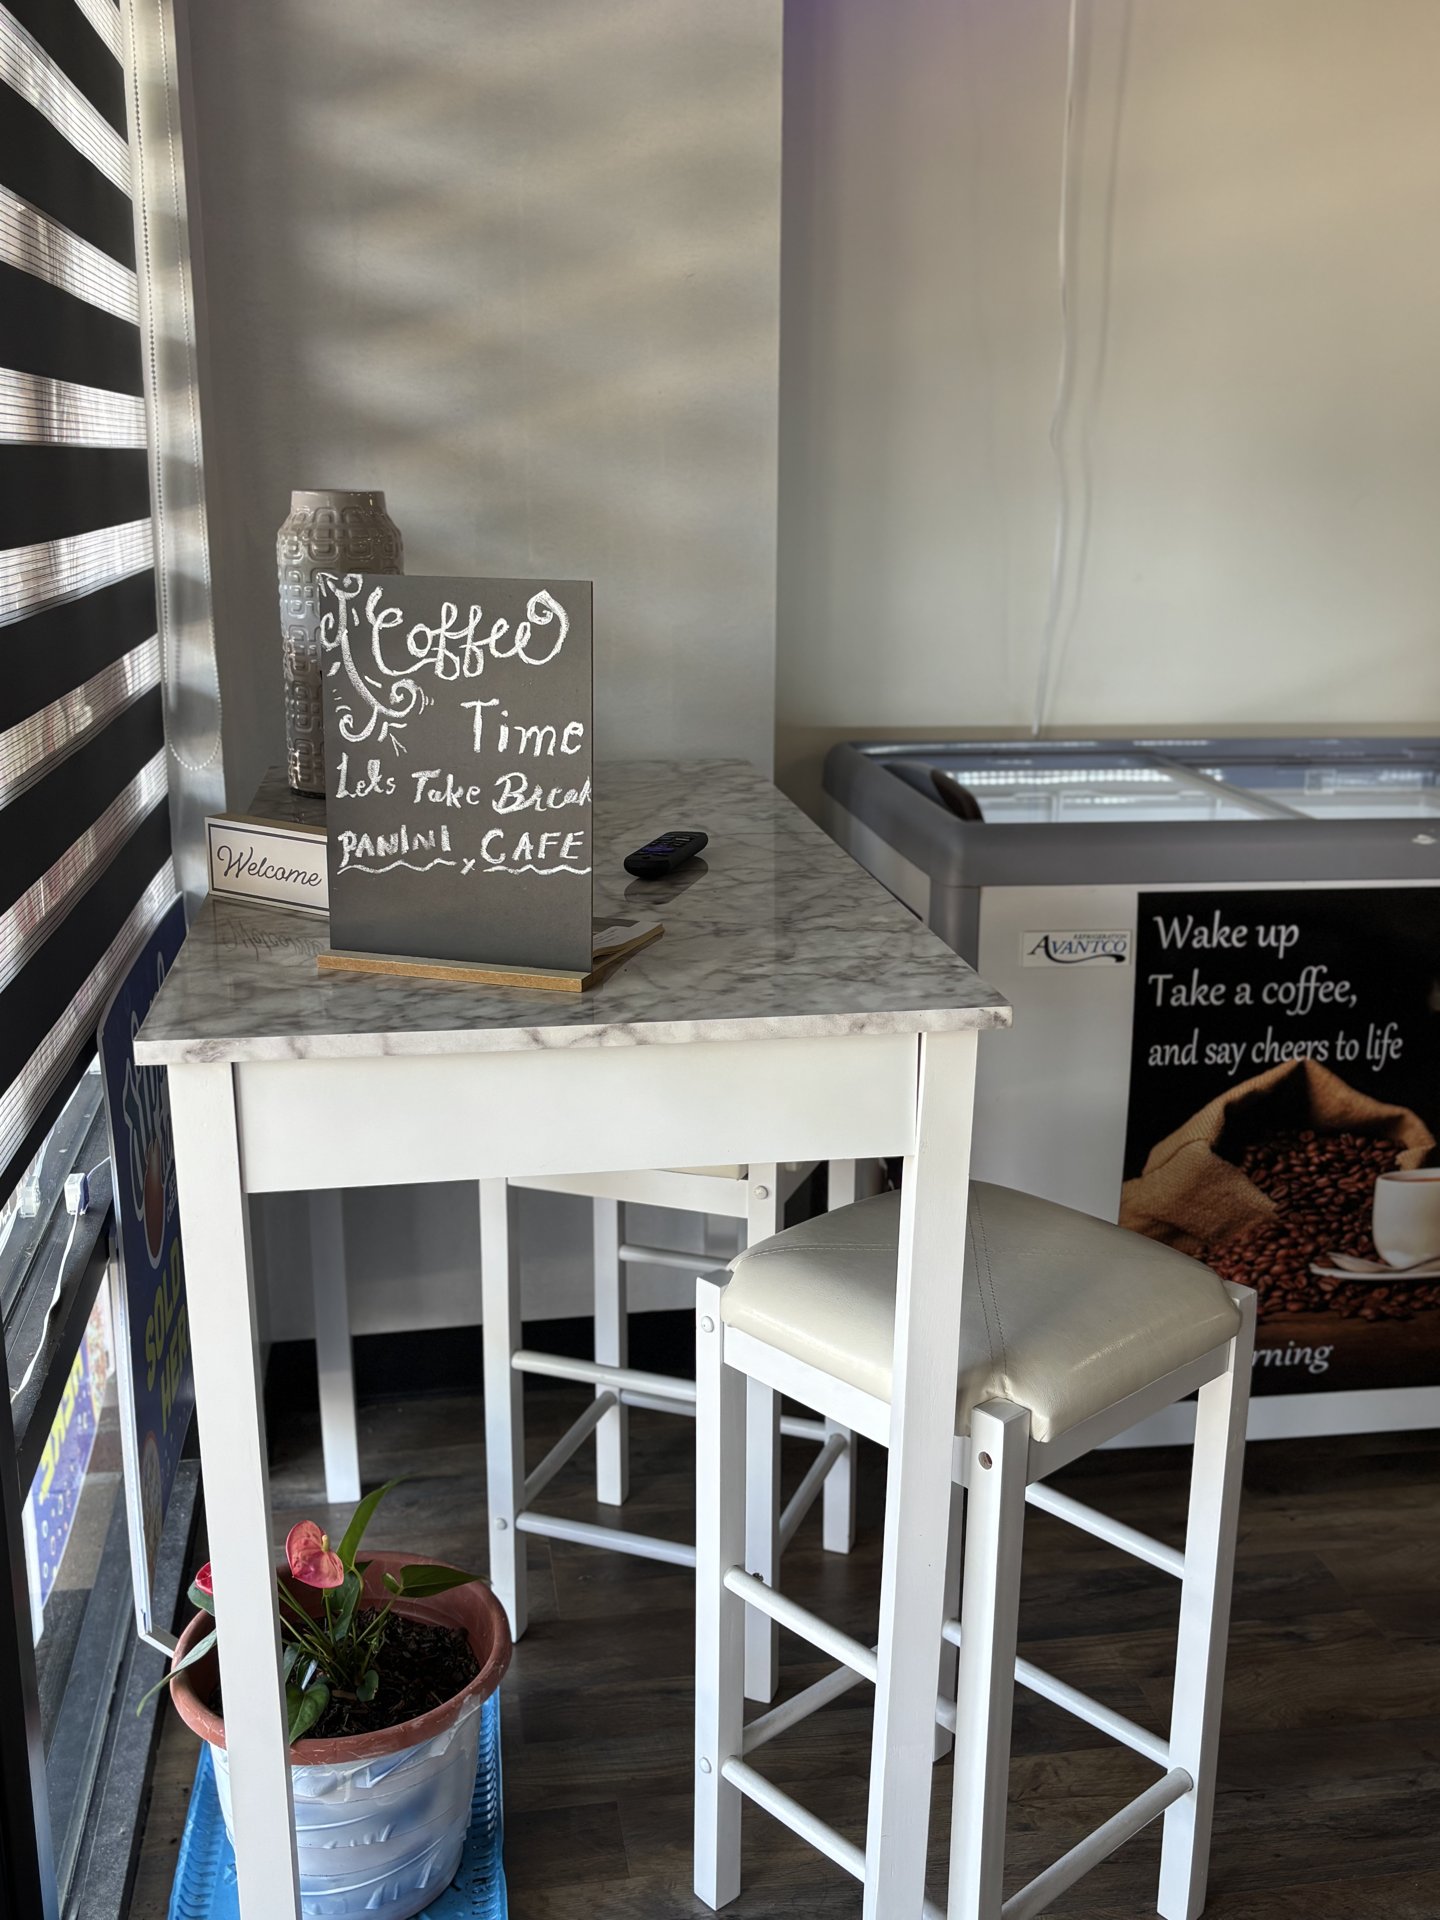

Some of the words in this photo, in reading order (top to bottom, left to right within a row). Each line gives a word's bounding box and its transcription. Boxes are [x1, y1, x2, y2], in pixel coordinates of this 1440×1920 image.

[366, 587, 569, 681] Coffee
[460, 698, 584, 757] Time
[411, 769, 481, 809] Take
[216, 845, 323, 887] Welcome
[337, 825, 452, 868] PANINI
[480, 828, 585, 864] CAFE
[1026, 934, 1127, 964] AVANTCO
[1153, 910, 1248, 950] Wake
[1256, 922, 1300, 960] up
[1148, 968, 1226, 1008] Take
[1233, 982, 1254, 1006] a
[1262, 965, 1358, 1016] coffee,
[1148, 1028, 1199, 1067] and
[1204, 1041, 1247, 1075] say
[1251, 1026, 1329, 1063] cheers
[1335, 1030, 1360, 1061] to
[1365, 1022, 1404, 1072] life
[145, 1236, 181, 1392] SOLD
[160, 1303, 190, 1437] HER
[1252, 1340, 1335, 1375] rning
